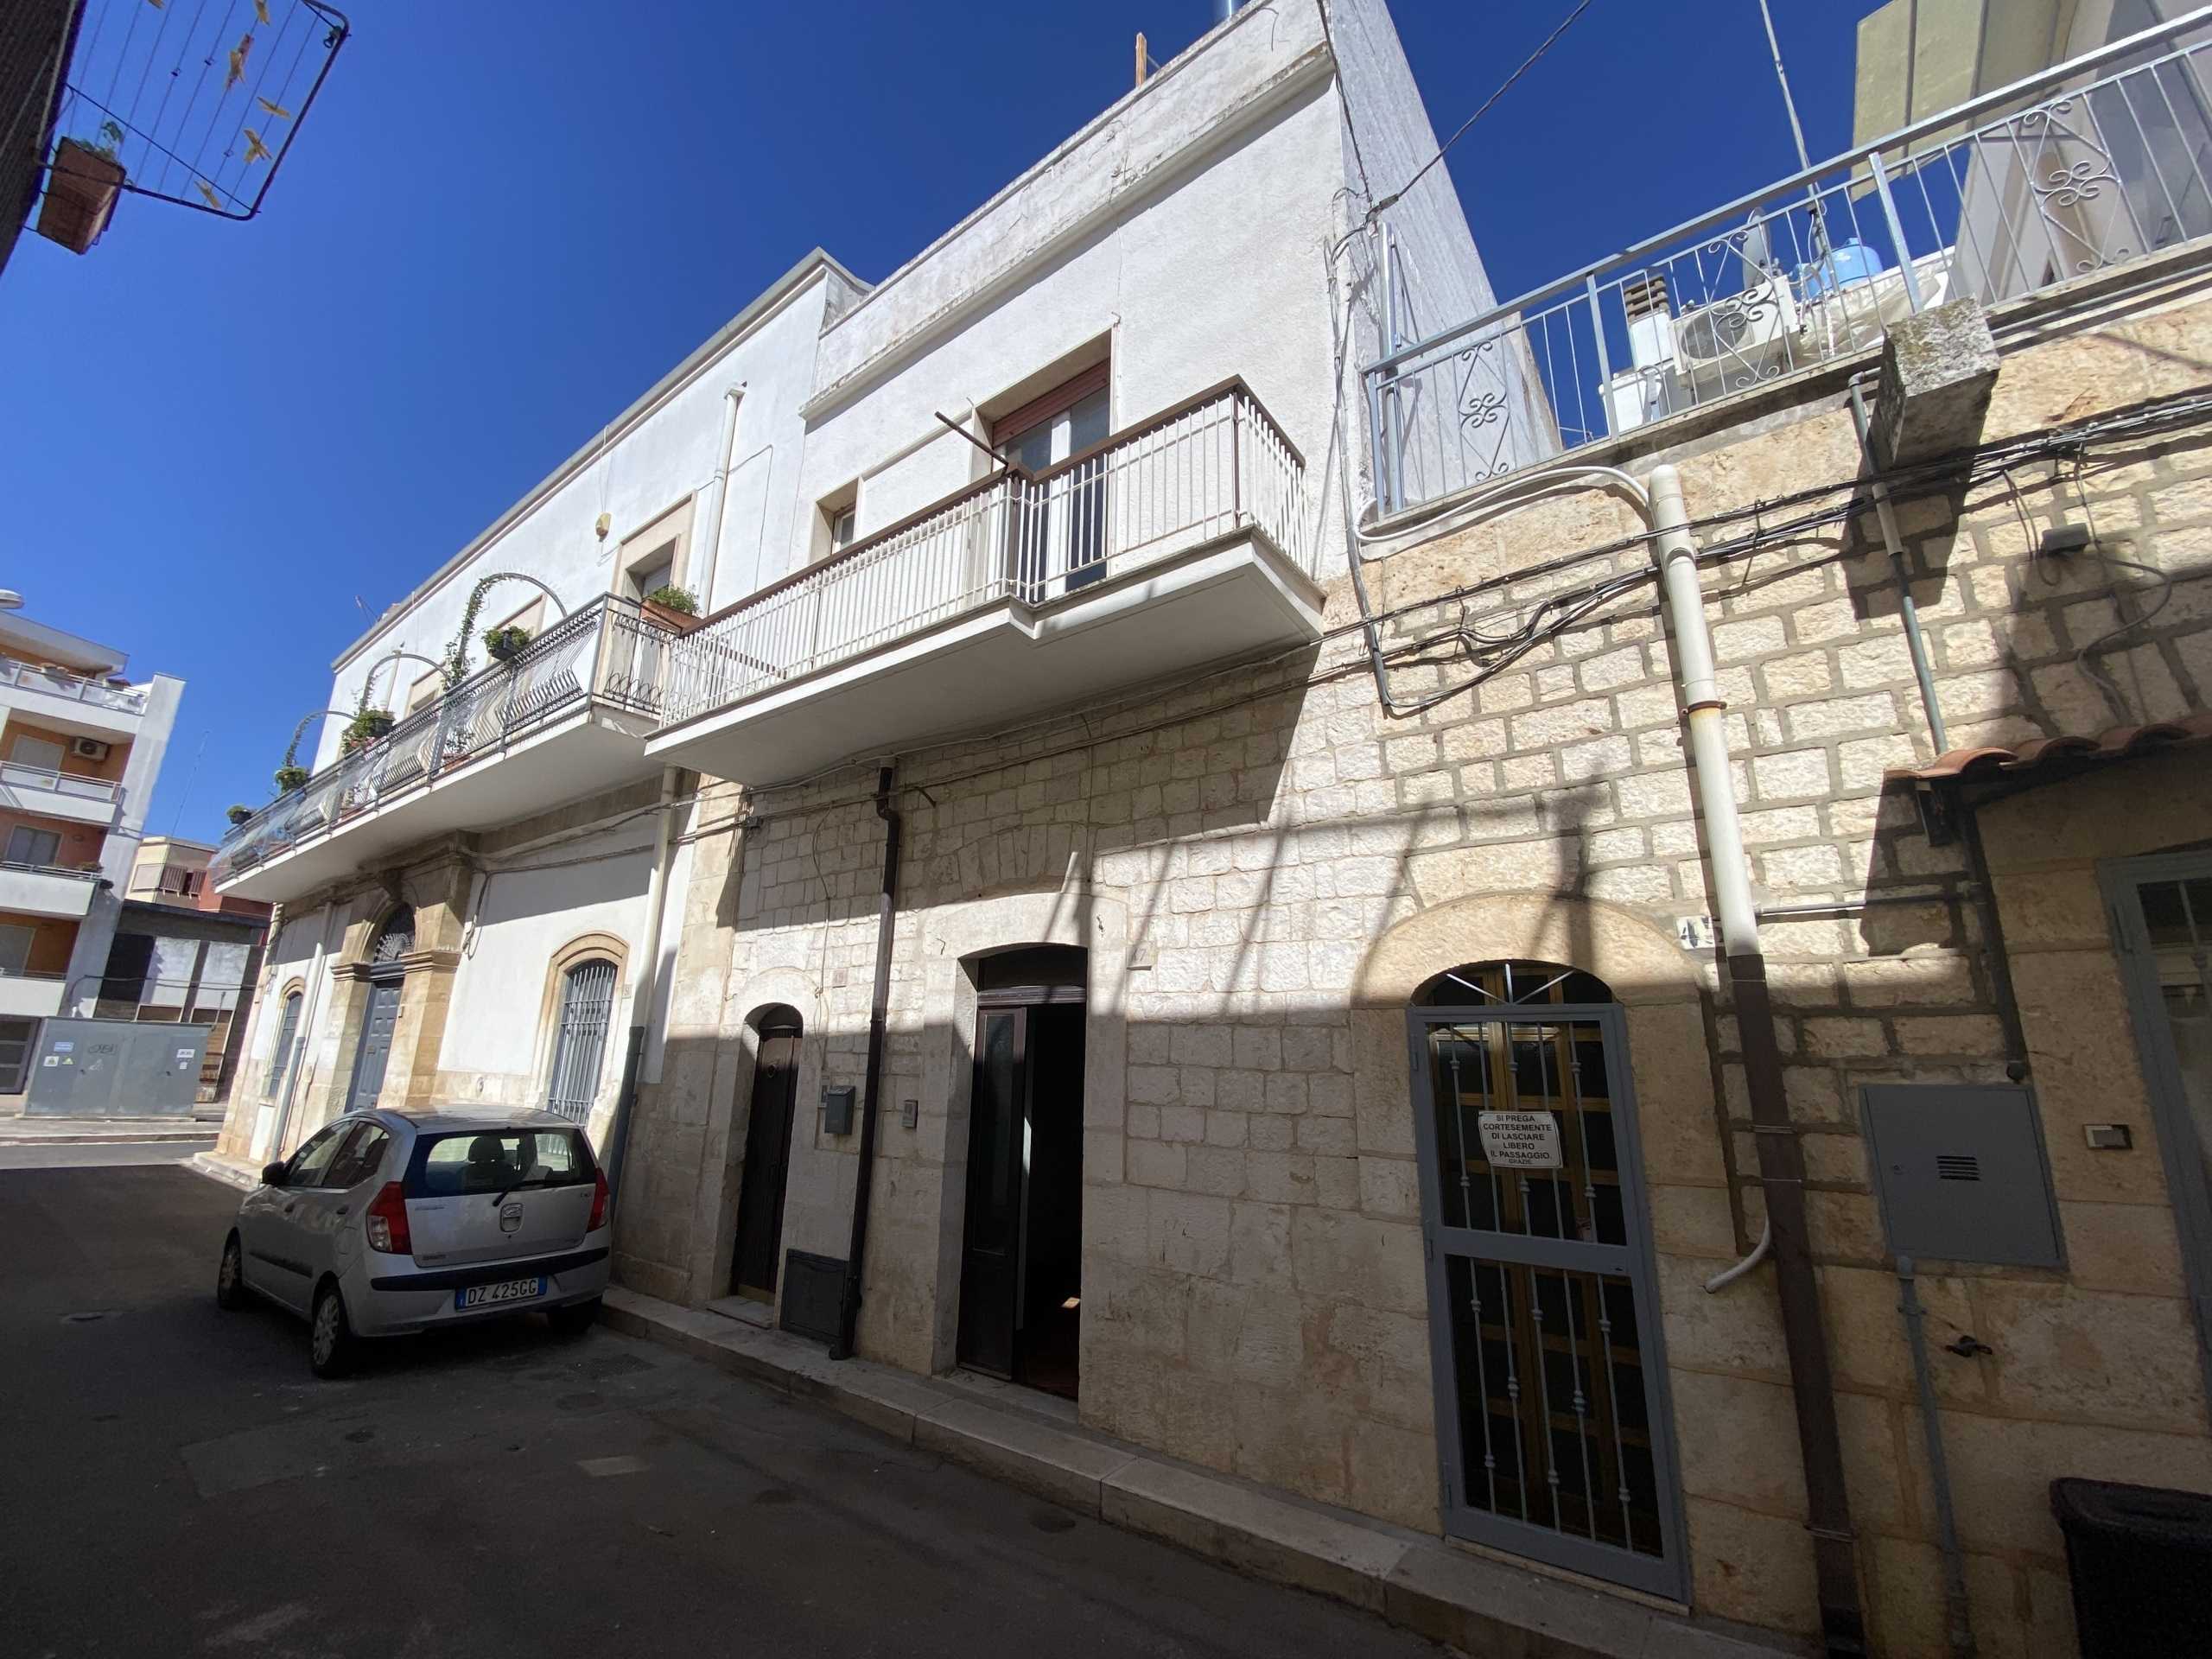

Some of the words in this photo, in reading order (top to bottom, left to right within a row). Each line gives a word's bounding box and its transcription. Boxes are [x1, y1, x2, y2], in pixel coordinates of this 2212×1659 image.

[1483, 1123, 1553, 1132] CORTESEMENTE
[1500, 1151, 1550, 1160] PASSAGGIO
[468, 1287, 487, 1304] DZ
[492, 1280, 537, 1299] 425GG
